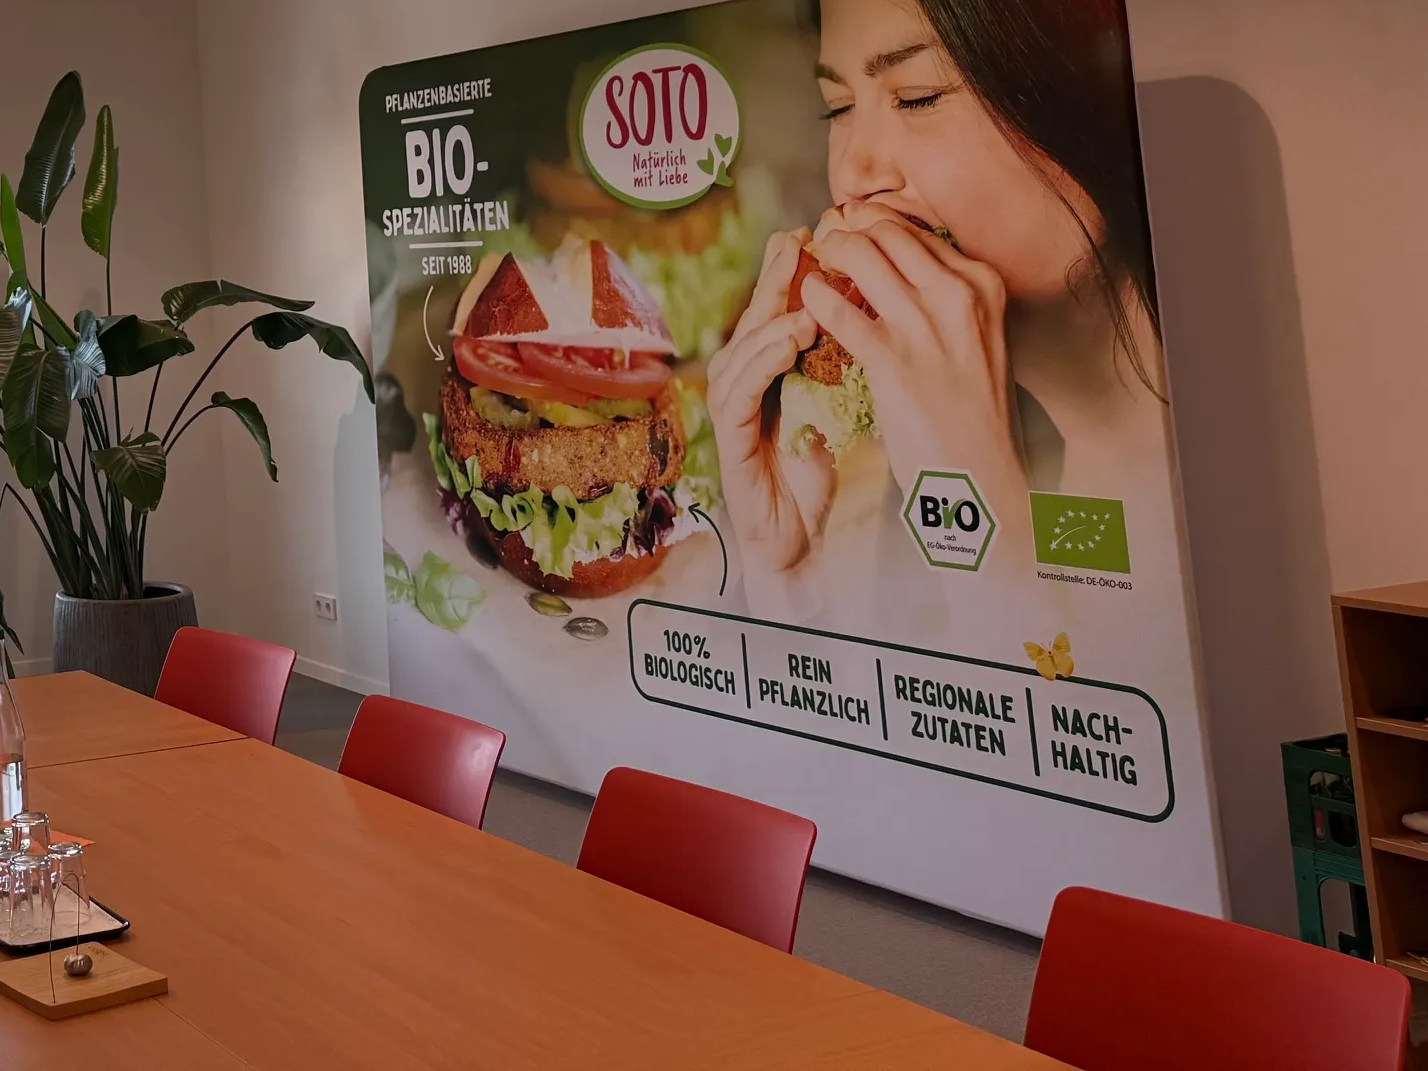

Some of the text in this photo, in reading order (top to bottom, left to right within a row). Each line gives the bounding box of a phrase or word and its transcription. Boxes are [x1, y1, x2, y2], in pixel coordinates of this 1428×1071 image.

[385, 77, 492, 113] PFLANZENBASIERTE
[605, 62, 708, 149] SOTO
[405, 124, 489, 199] BIO-
[632, 148, 687, 173] Natürlich
[633, 168, 688, 188] mit Liebe
[382, 199, 510, 237] SPEZIALITÄTEN
[421, 254, 472, 275] SEIT 1988
[944, 534, 957, 542] nach
[1037, 570, 1133, 591] Kontrollstelle: DE-ÖKO-003
[663, 629, 711, 660] 100%
[644, 652, 736, 696] BIOLOGISCH
[788, 653, 832, 685] REIN
[758, 677, 871, 726] PFLANZLICH
[894, 674, 1016, 724] REGIONALE
[910, 710, 1007, 757] ZUTATEN
[1050, 704, 1133, 746] NACH-
[1050, 740, 1137, 788] HALTIG
